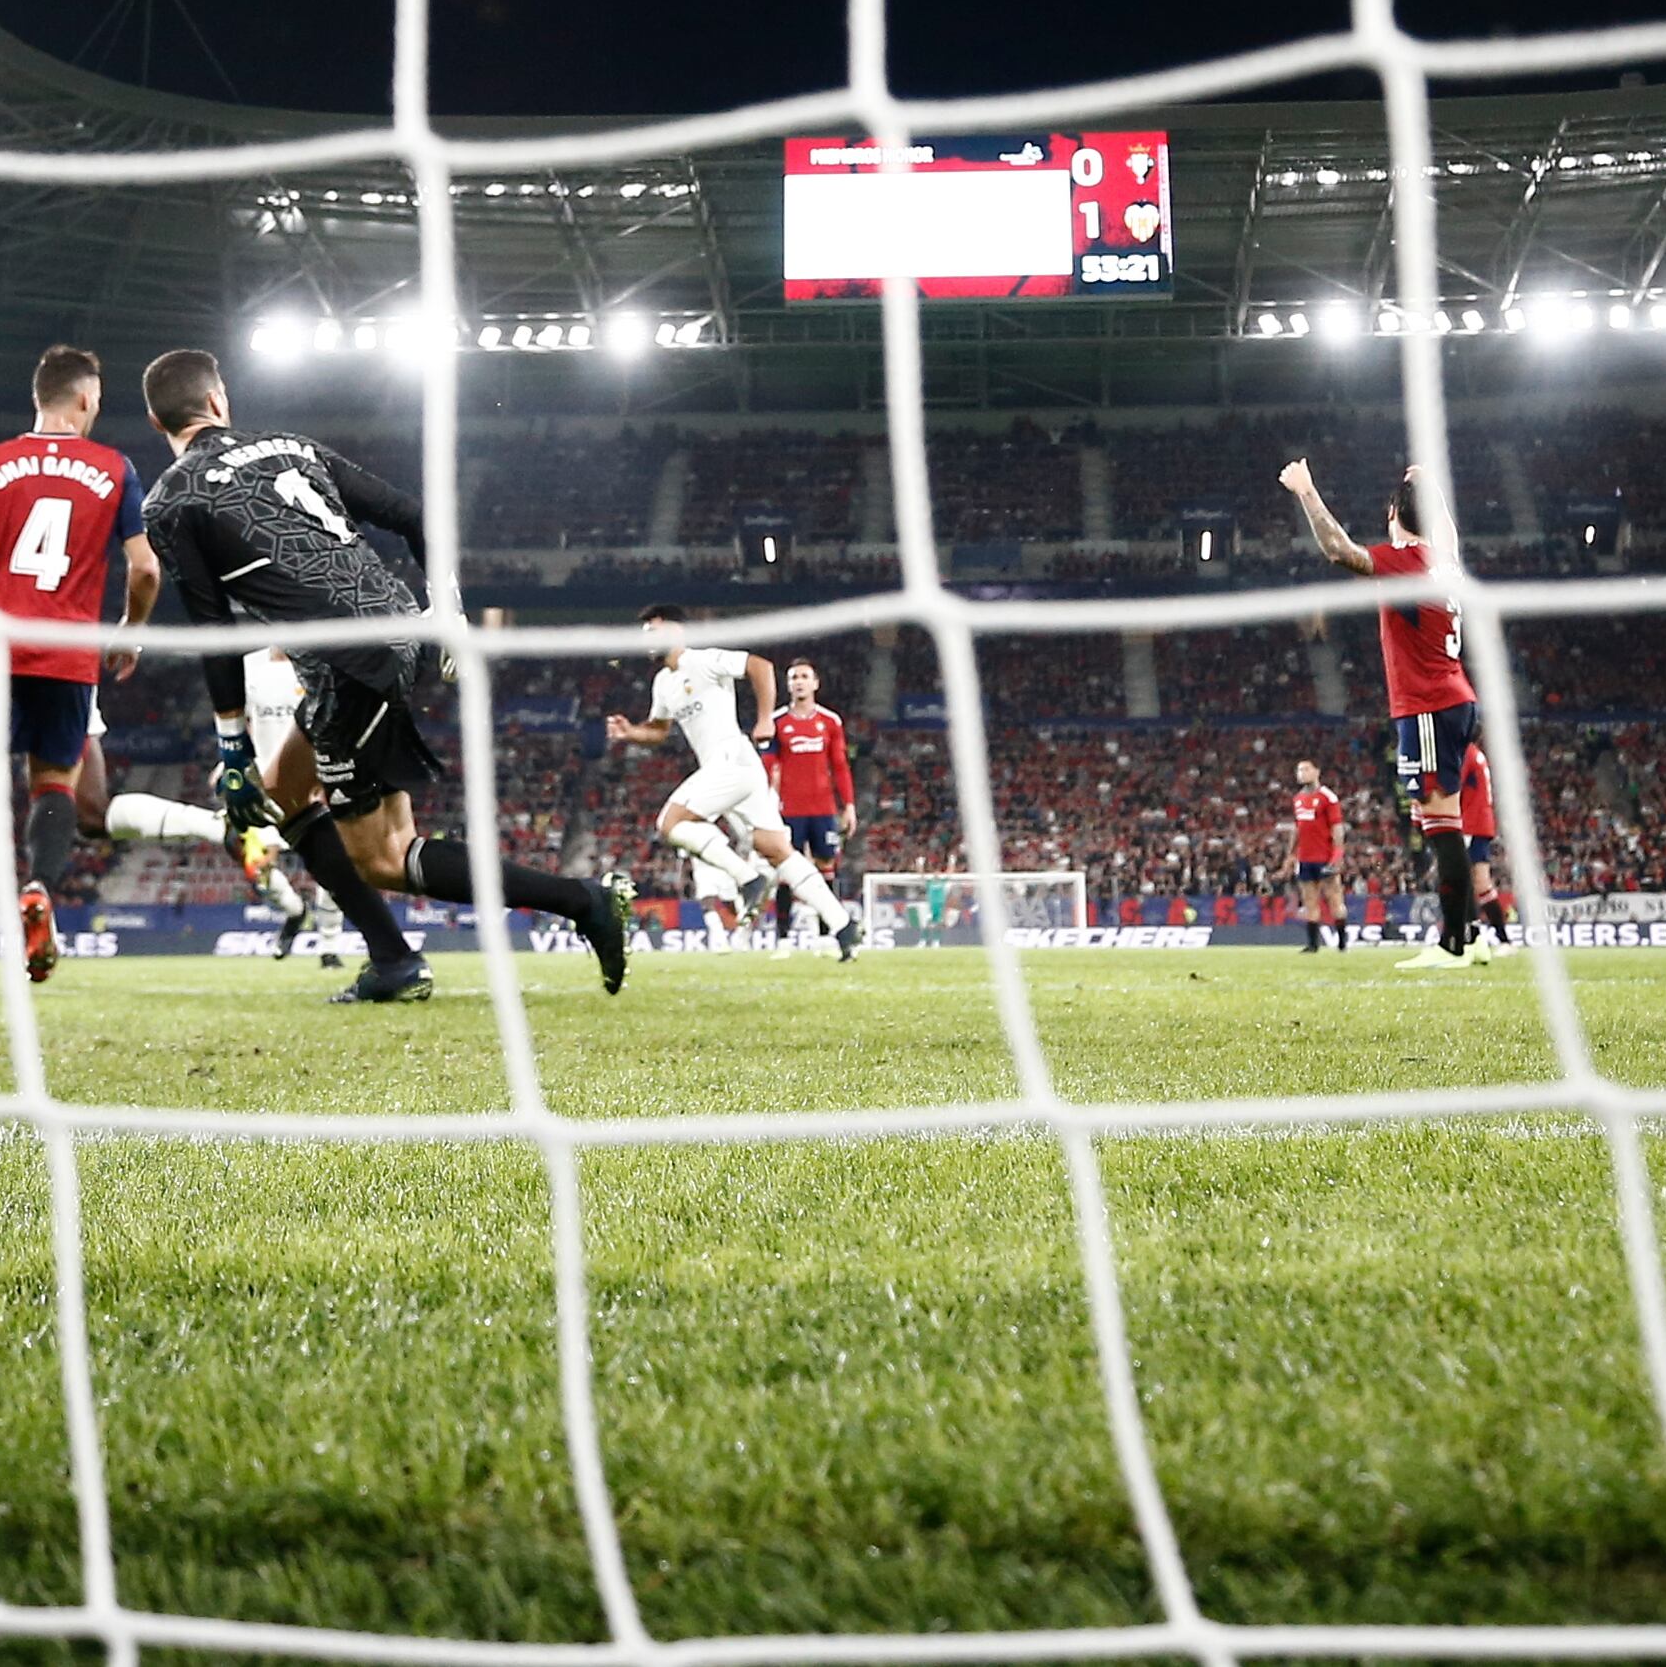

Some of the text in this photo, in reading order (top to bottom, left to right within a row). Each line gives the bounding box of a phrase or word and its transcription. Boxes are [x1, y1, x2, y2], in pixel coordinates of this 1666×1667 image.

[1072, 148, 1103, 186] 0
[1079, 201, 1100, 239] 1
[1082, 254, 1159, 282] 53:21
[42, 455, 115, 500] GARCÍA
[274, 468, 357, 545] 1
[9, 497, 73, 592] 4
[1004, 926, 1213, 948] SKECHERS
